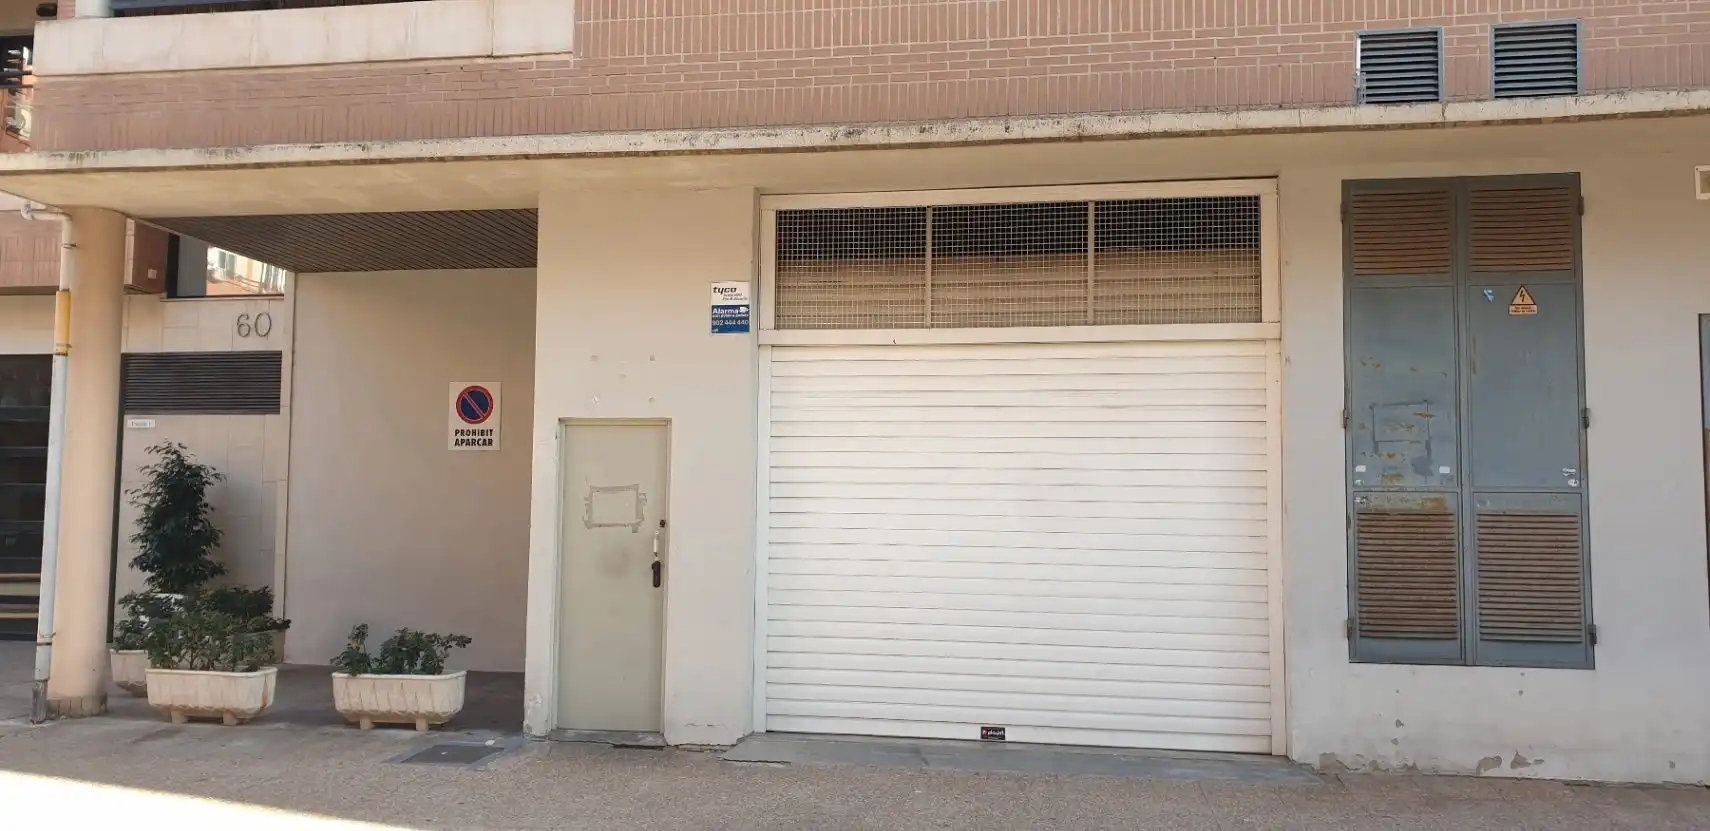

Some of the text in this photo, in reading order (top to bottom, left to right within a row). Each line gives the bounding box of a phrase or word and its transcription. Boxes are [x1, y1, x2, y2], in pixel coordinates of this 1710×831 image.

[713, 286, 737, 295] tyco
[236, 312, 272, 338] 60
[454, 429, 494, 437] PROHIBIT
[454, 438, 494, 447] APARCAR
